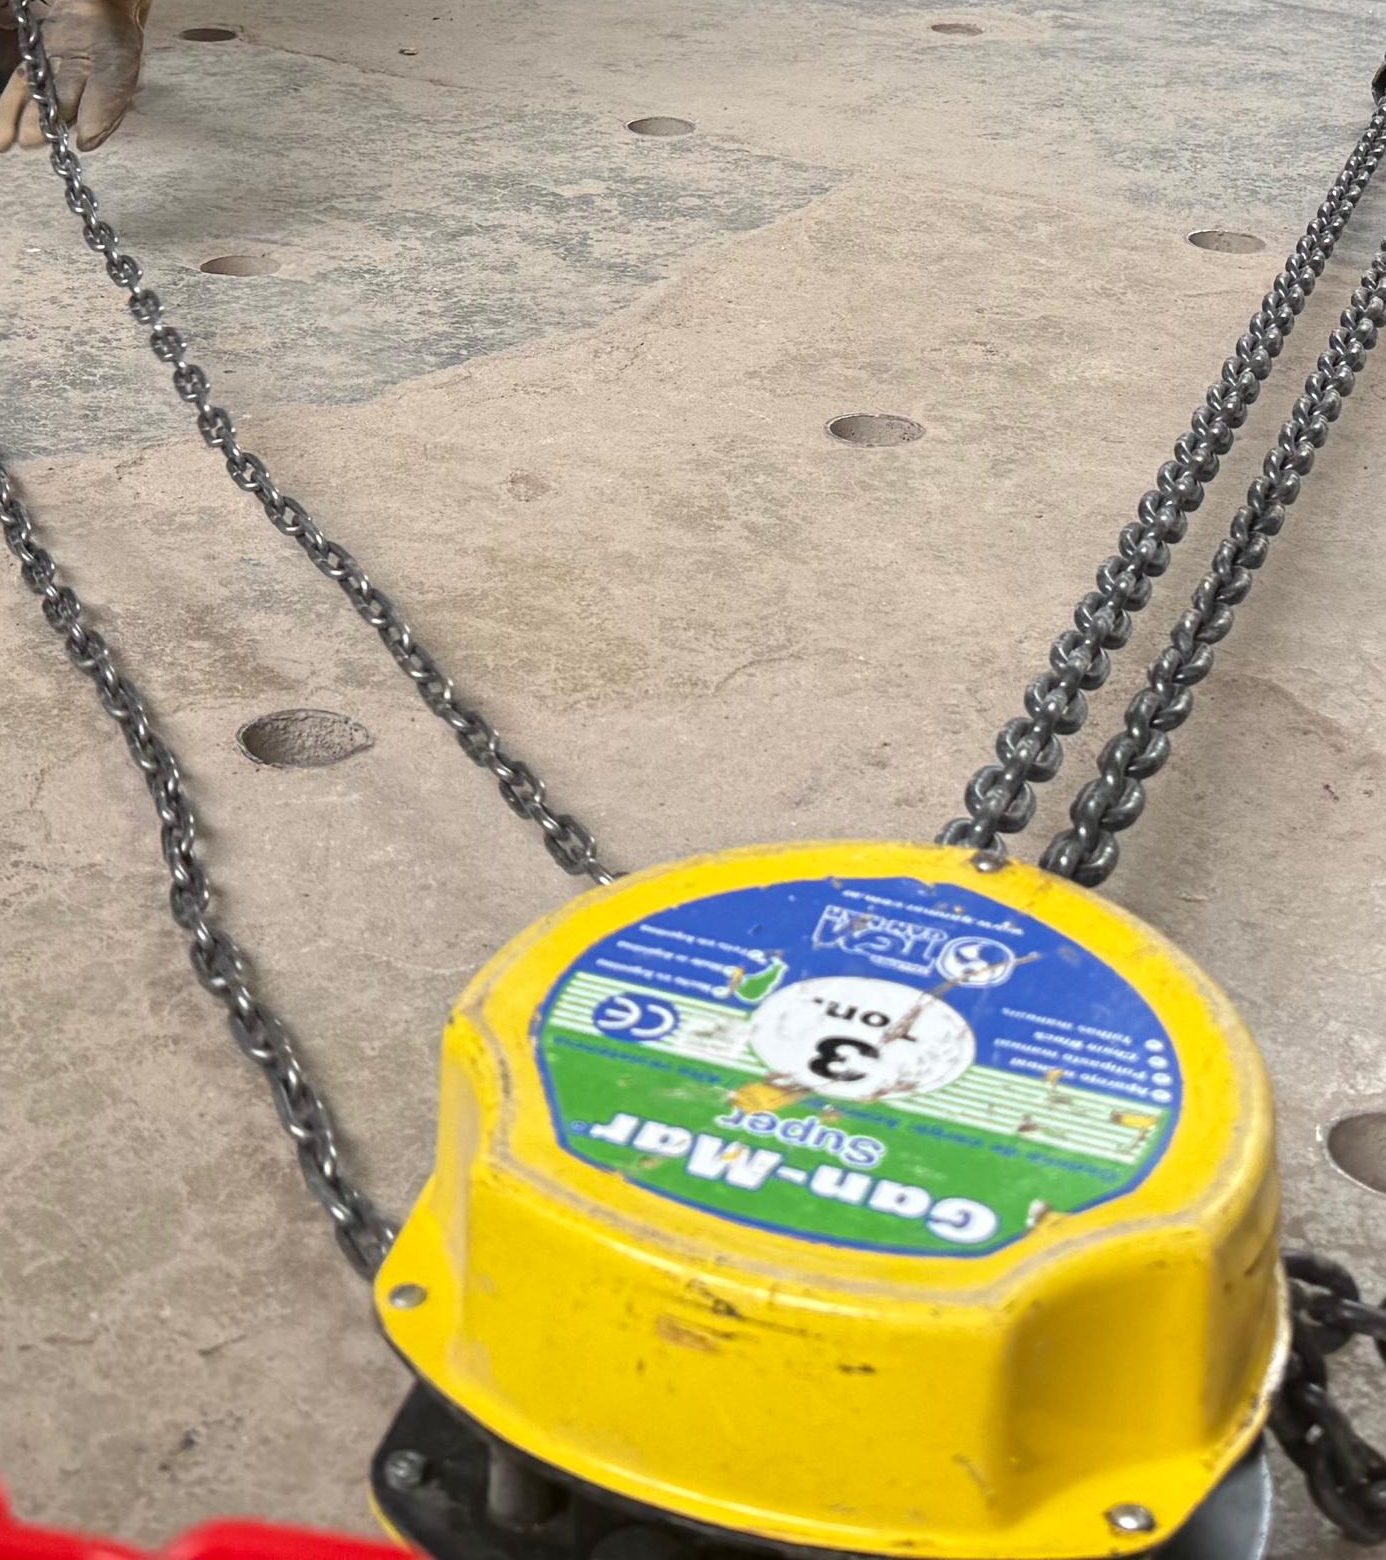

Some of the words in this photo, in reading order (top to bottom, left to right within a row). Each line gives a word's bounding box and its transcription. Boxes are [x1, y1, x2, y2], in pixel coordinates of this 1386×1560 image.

[598, 996, 675, 1038] CE
[808, 1037, 879, 1082] 3
[714, 1109, 886, 1168] Super
[589, 1111, 1000, 1244] Gan-Mar
